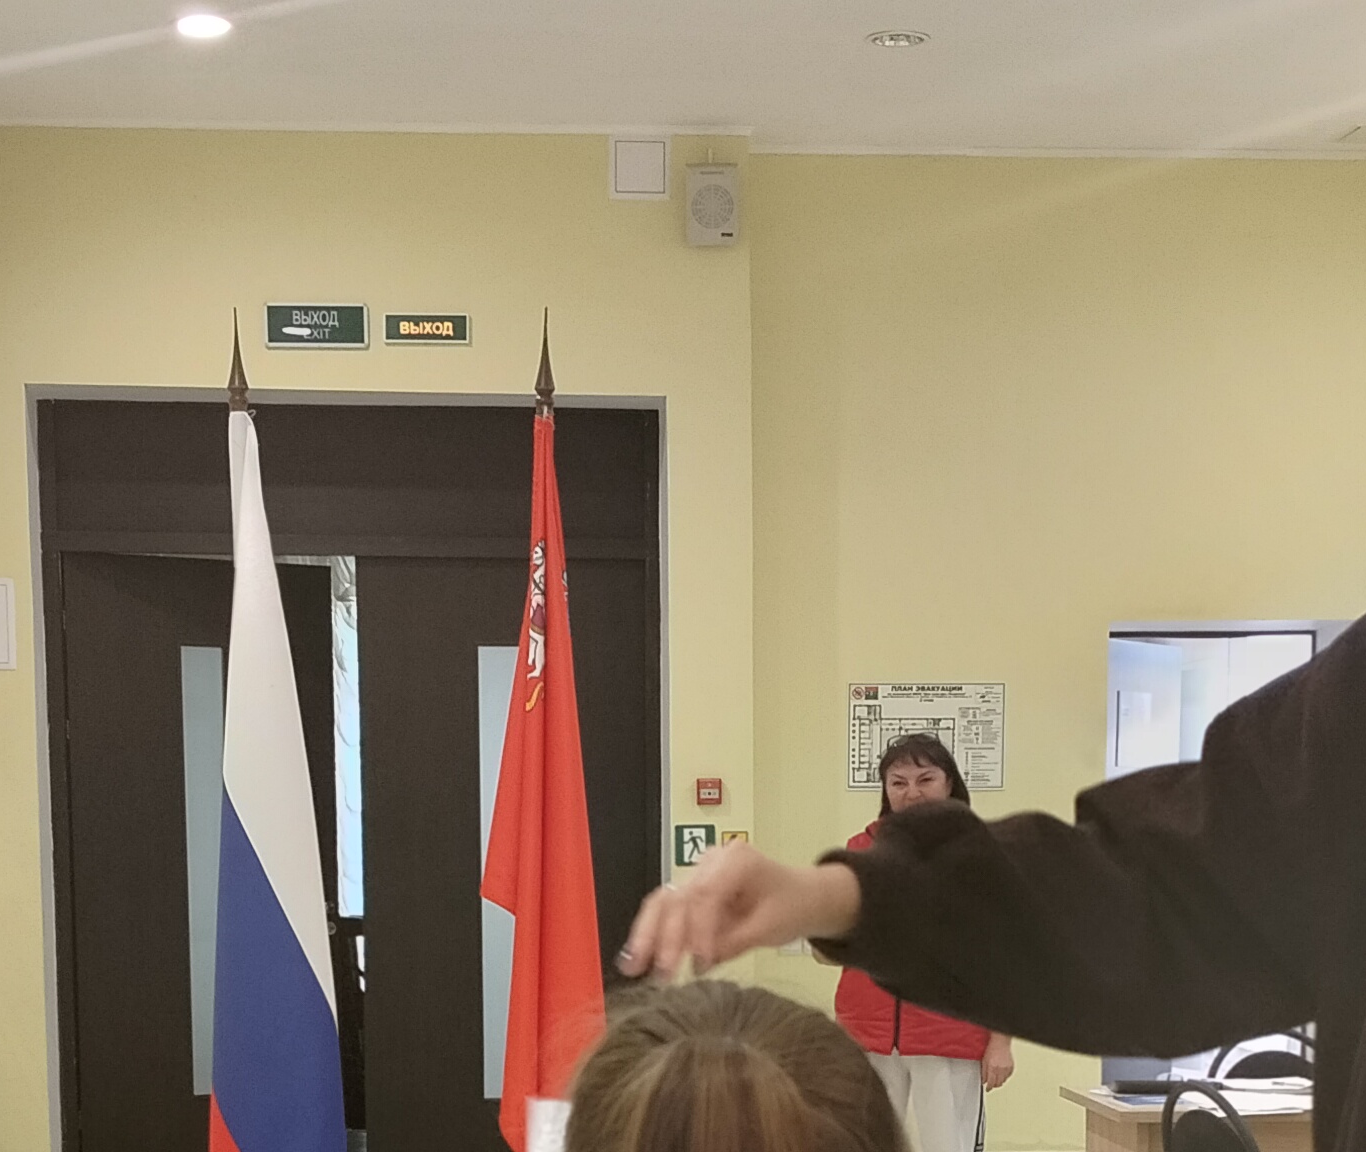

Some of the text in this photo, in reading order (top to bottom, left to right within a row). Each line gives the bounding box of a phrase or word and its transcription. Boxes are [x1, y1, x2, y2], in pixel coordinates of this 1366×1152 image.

[292, 310, 339, 328] ВЫХОД
[399, 321, 454, 336] ВЫХОД
[915, 685, 963, 693] ЭВАКУАЦИИ
